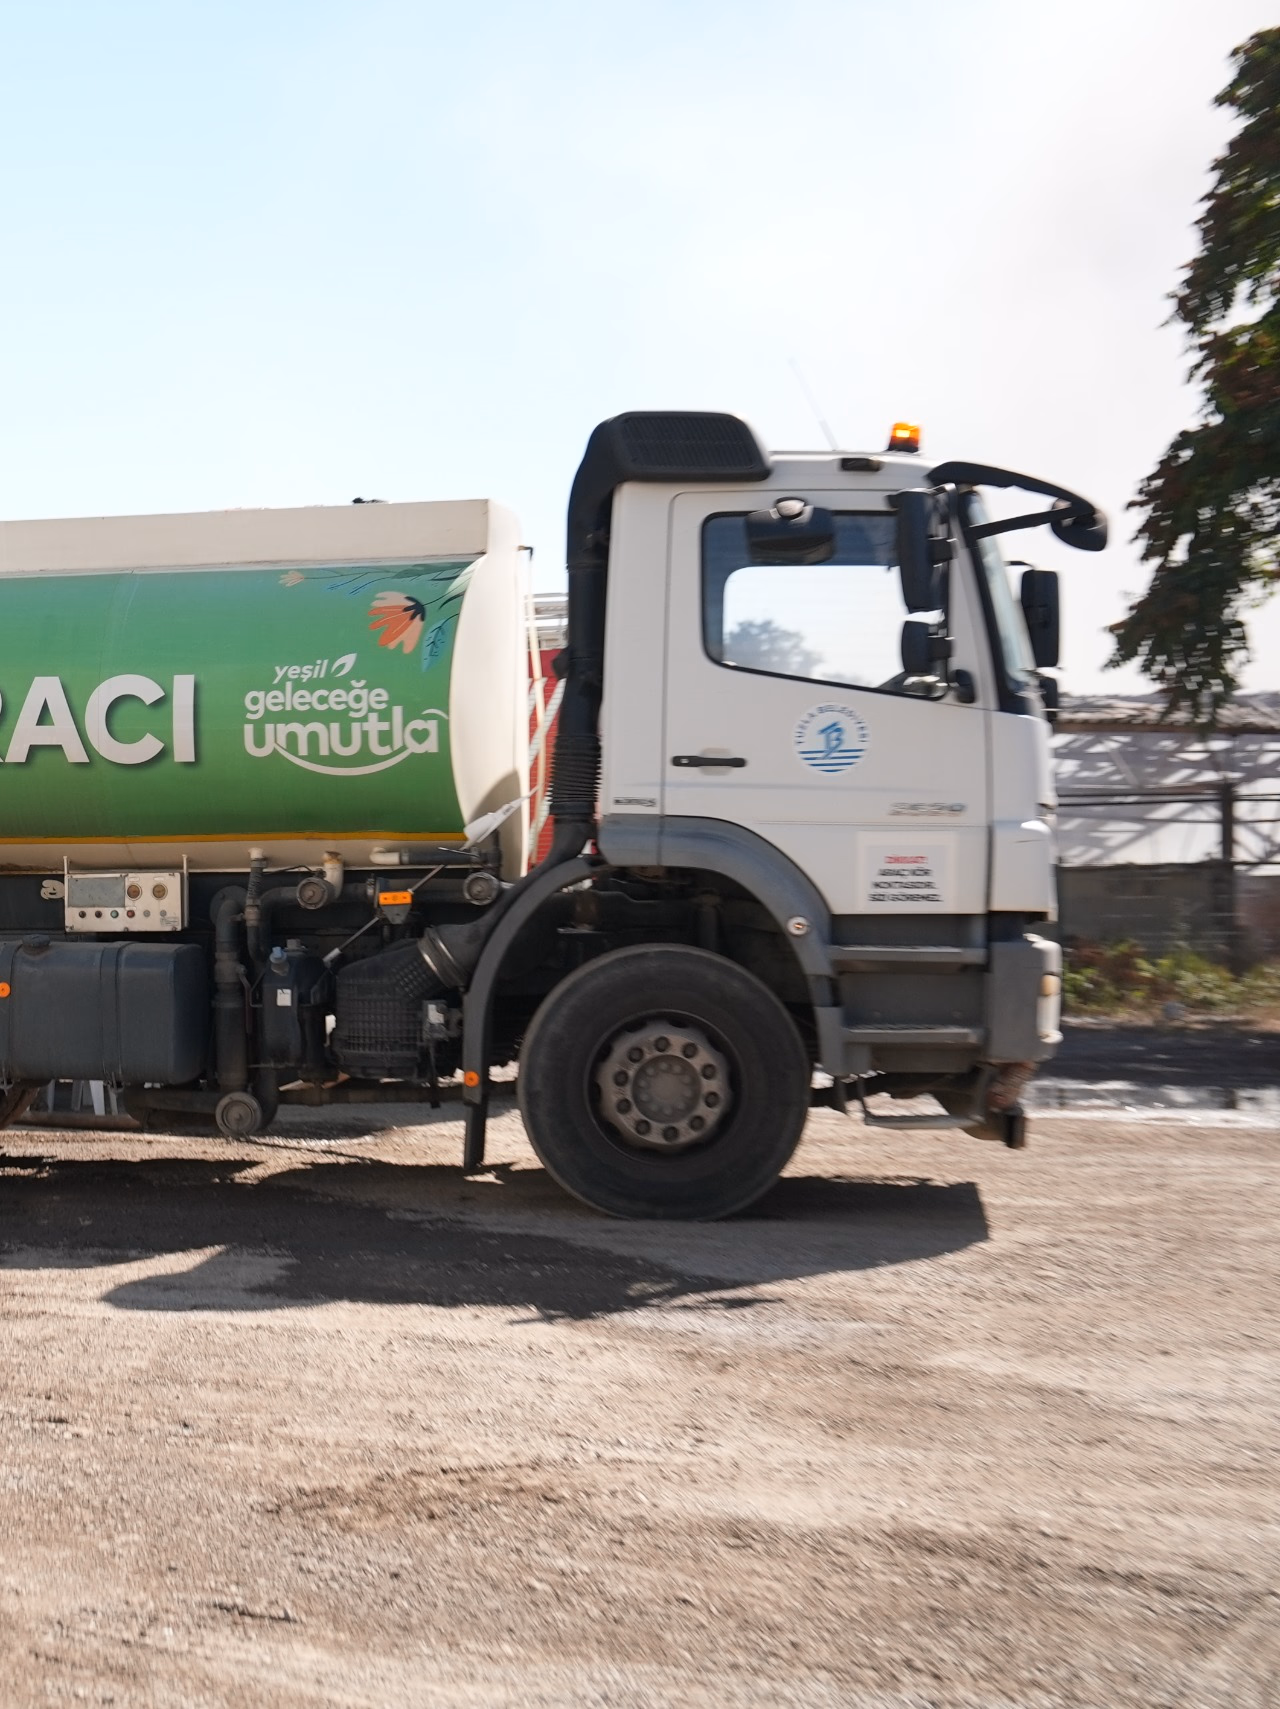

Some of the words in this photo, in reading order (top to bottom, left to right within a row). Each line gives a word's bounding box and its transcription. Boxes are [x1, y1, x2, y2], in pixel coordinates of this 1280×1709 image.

[272, 659, 329, 684] yeşil
[244, 679, 389, 720] geleceğe
[244, 705, 439, 758] umutla
